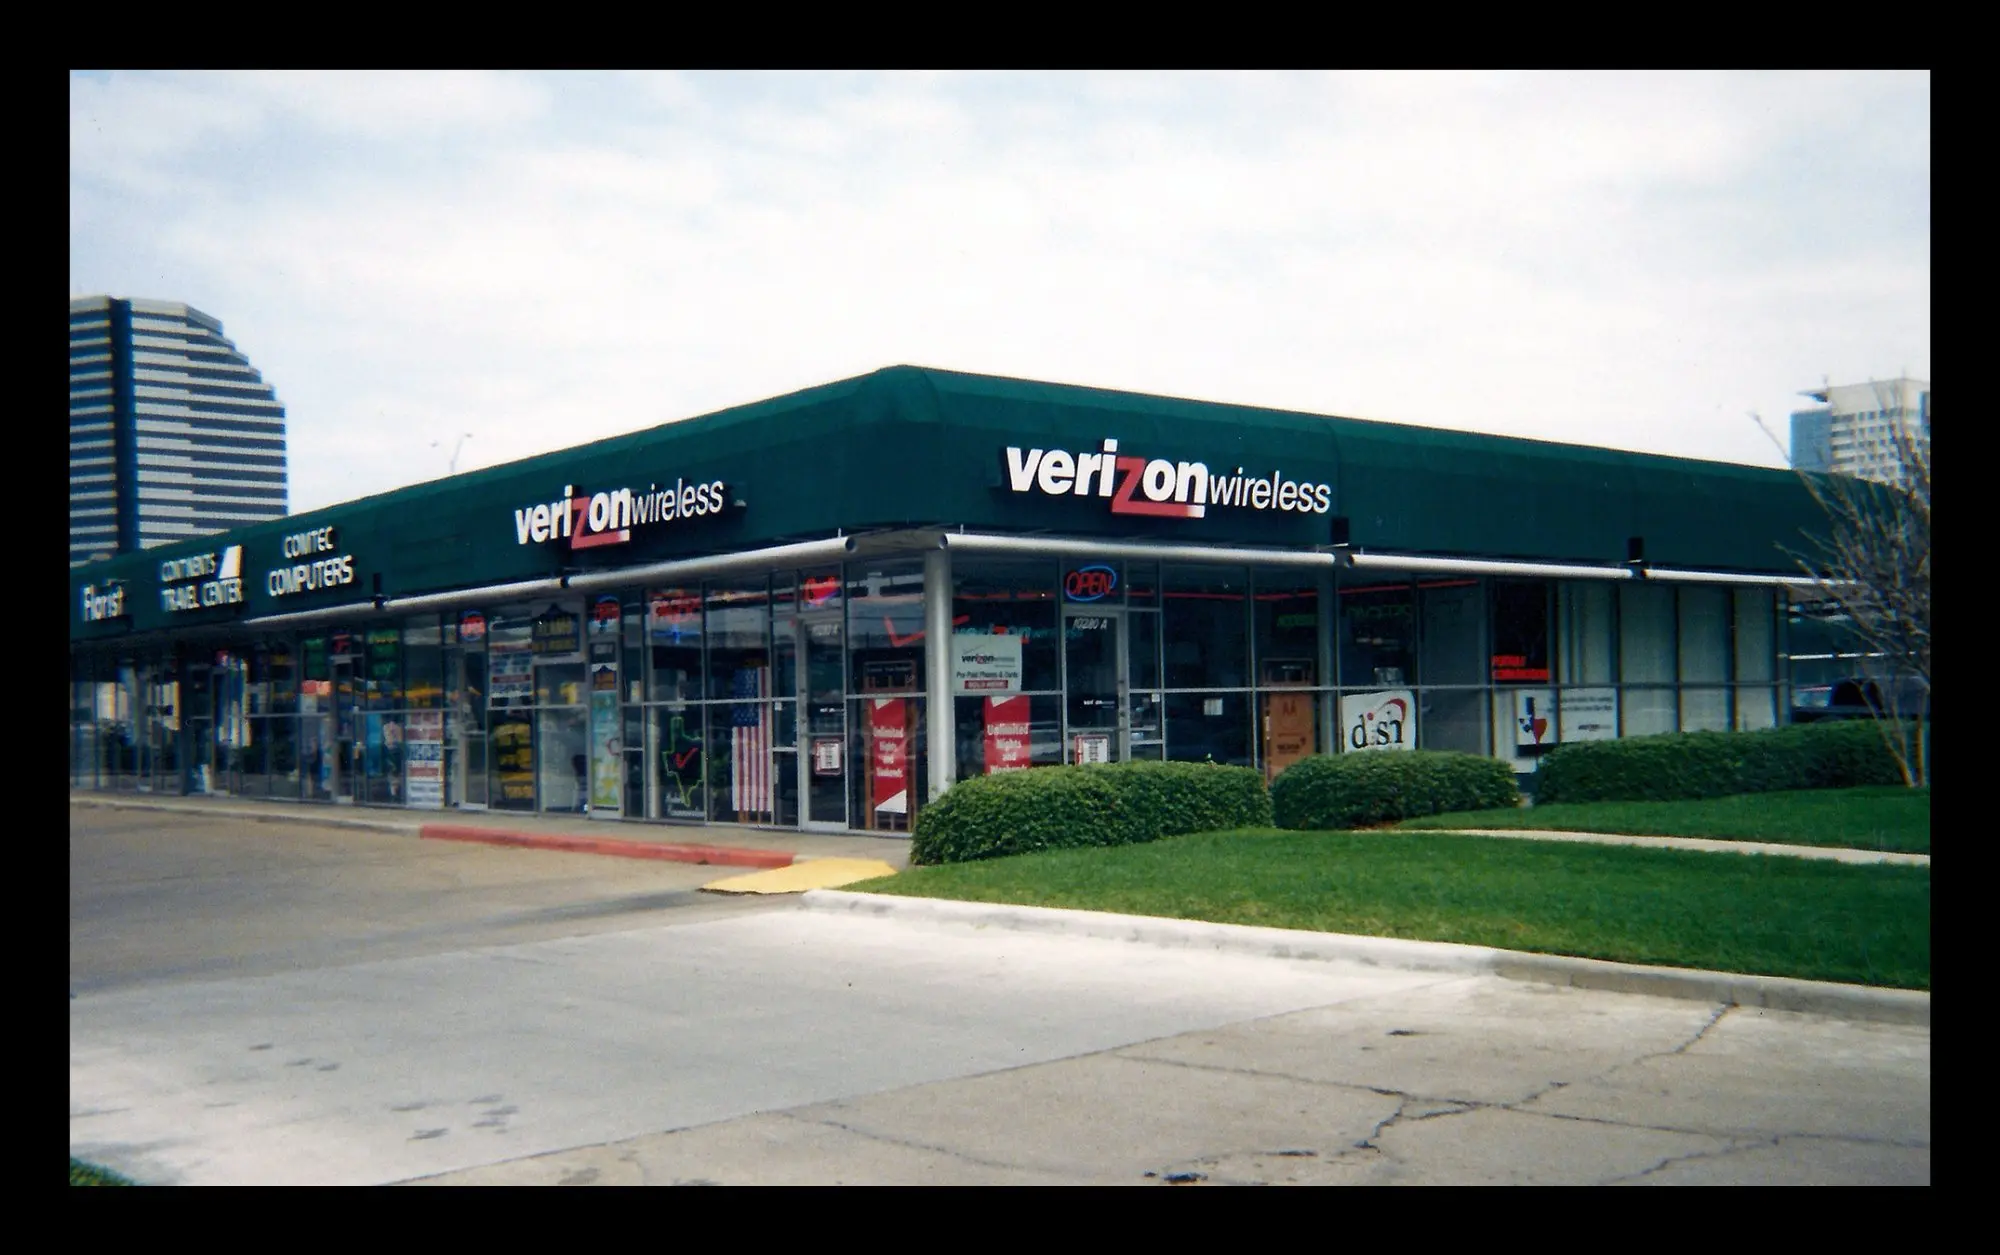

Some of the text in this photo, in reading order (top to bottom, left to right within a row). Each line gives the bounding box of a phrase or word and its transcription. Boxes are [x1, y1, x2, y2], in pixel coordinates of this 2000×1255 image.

[1006, 438, 1331, 518] verizon wireless
[515, 478, 724, 549] verizon wireless
[202, 577, 243, 607] CENTER
[268, 555, 353, 596] COMPUTERS
[1066, 571, 1113, 596] OPEN
